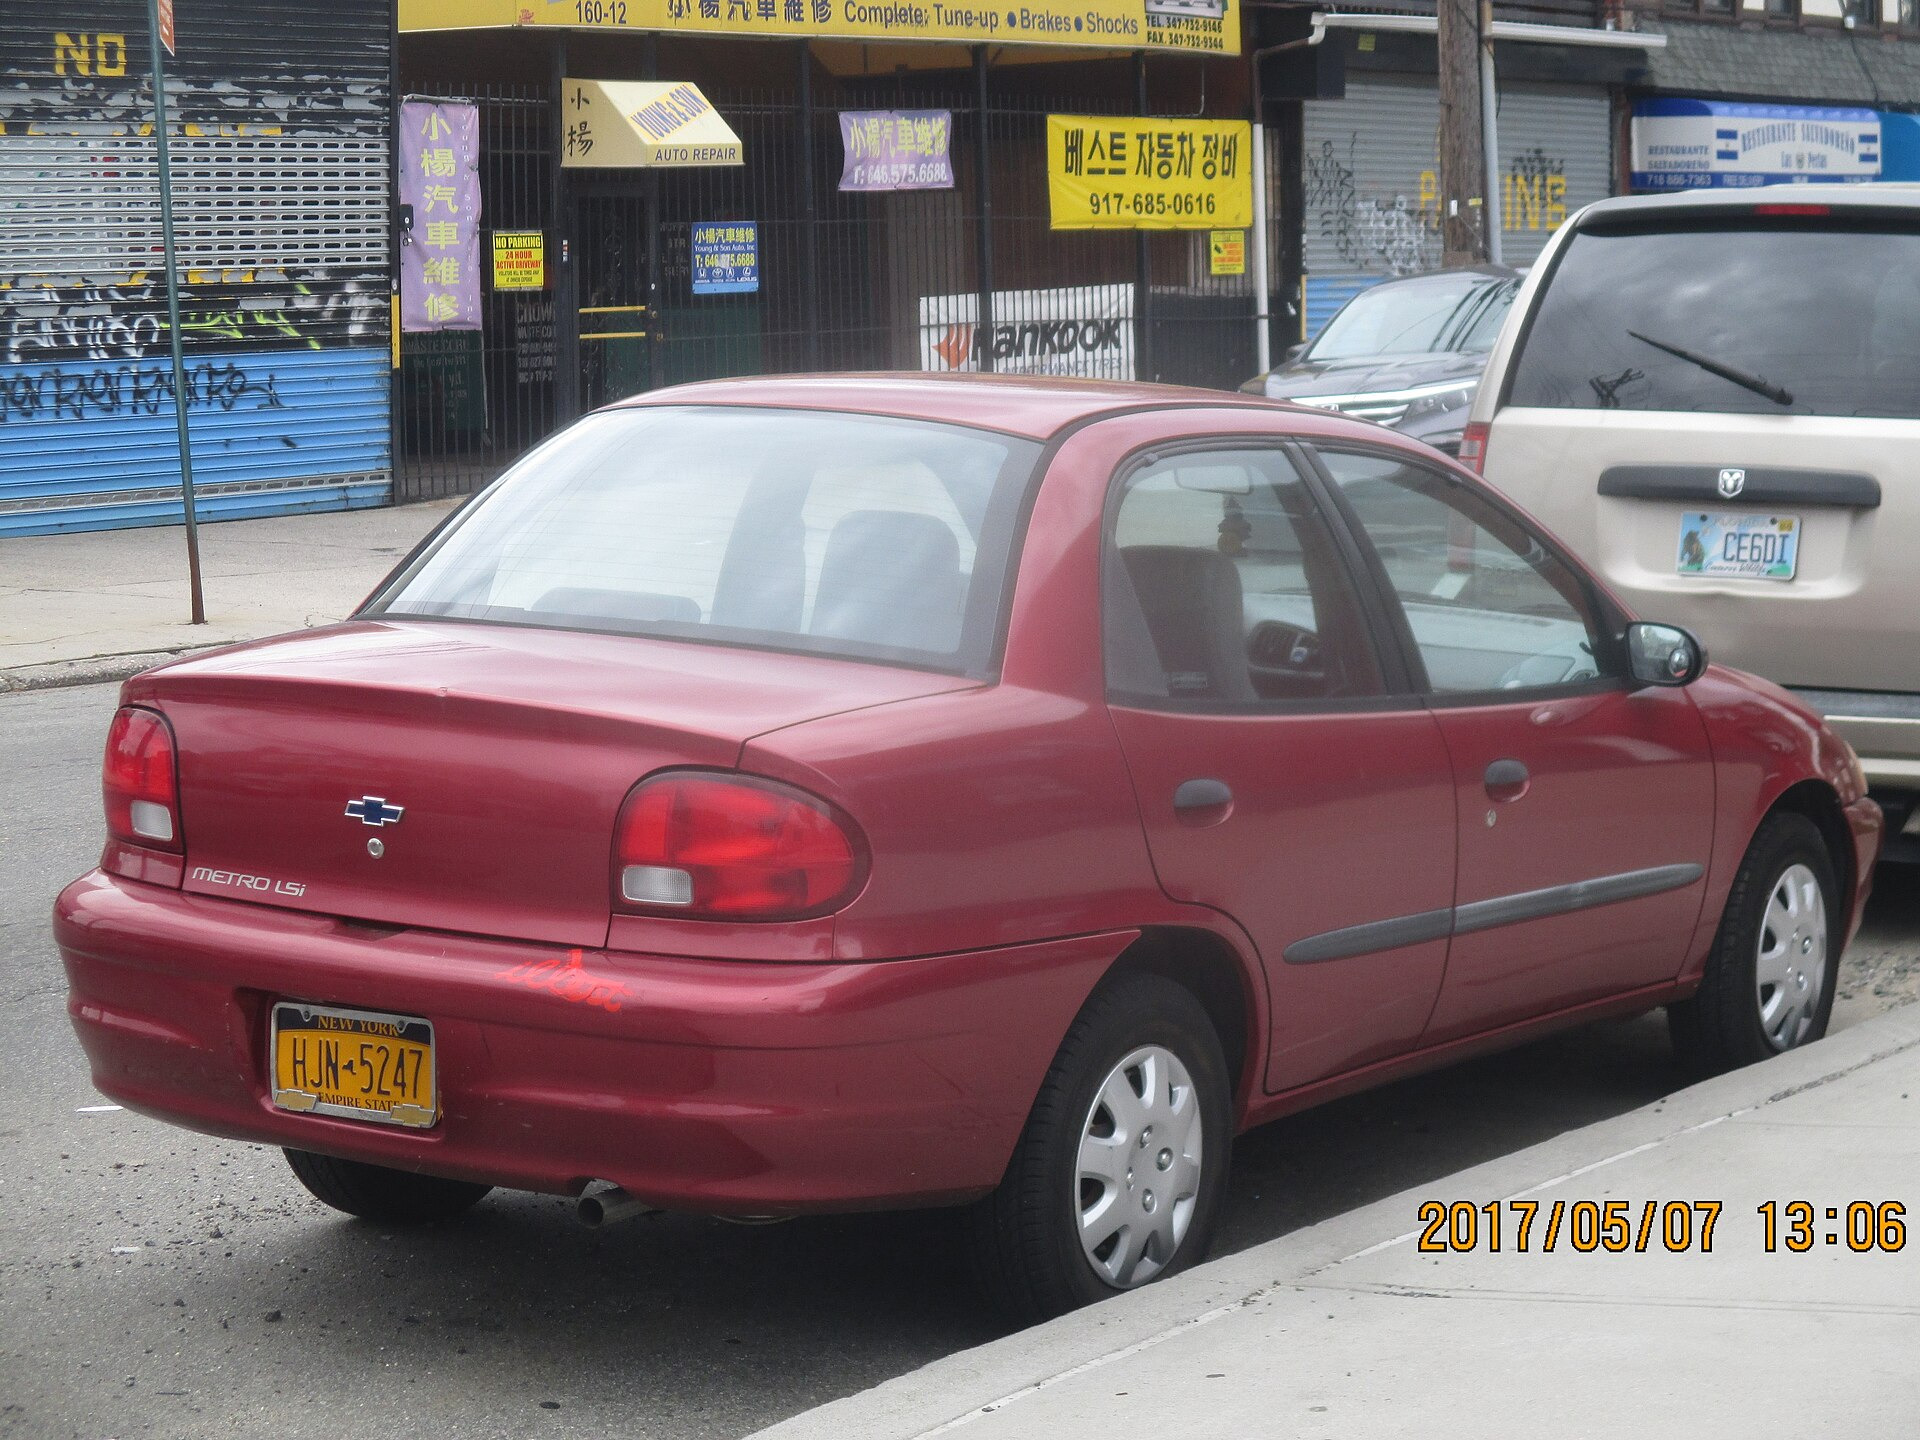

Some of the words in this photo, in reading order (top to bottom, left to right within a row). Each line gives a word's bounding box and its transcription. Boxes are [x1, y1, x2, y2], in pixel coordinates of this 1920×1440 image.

[575, 0, 627, 24] 160-12
[933, 3, 999, 32] Tune-up
[1020, 9, 1072, 32] Brakes
[1086, 12, 1139, 35] Shocks
[1147, 31, 1167, 44] FAX.
[54, 31, 127, 76] NO
[566, 87, 594, 157] 小楊
[630, 100, 683, 141] YOUNG
[669, 84, 709, 118] SON
[655, 149, 688, 161] AUTO
[693, 148, 736, 160] REPAIR
[1064, 128, 1126, 176] 베스트
[1135, 131, 1195, 179] 자동차
[1202, 133, 1237, 179] 정비
[867, 163, 947, 184] 646.575.6688
[1089, 192, 1216, 215] 917-685-0616
[420, 112, 460, 321] 小楊汽車維修
[495, 237, 507, 248] NO
[508, 236, 541, 248] PARKING
[694, 227, 755, 243] 小楊汽車維修
[505, 251, 513, 259] 24
[515, 251, 533, 259] HOUR
[694, 244, 713, 253] Young
[720, 243, 731, 251] Son
[496, 260, 514, 269] ACTIVE
[192, 867, 271, 891] METRO
[274, 880, 306, 897] LSi
[317, 1016, 355, 1031] NEW
[359, 1021, 400, 1037] YORK
[292, 1036, 339, 1090] HJN
[359, 1043, 423, 1099] 5247
[318, 1092, 361, 1108] EMPIRE
[365, 1099, 400, 1112] STATE
